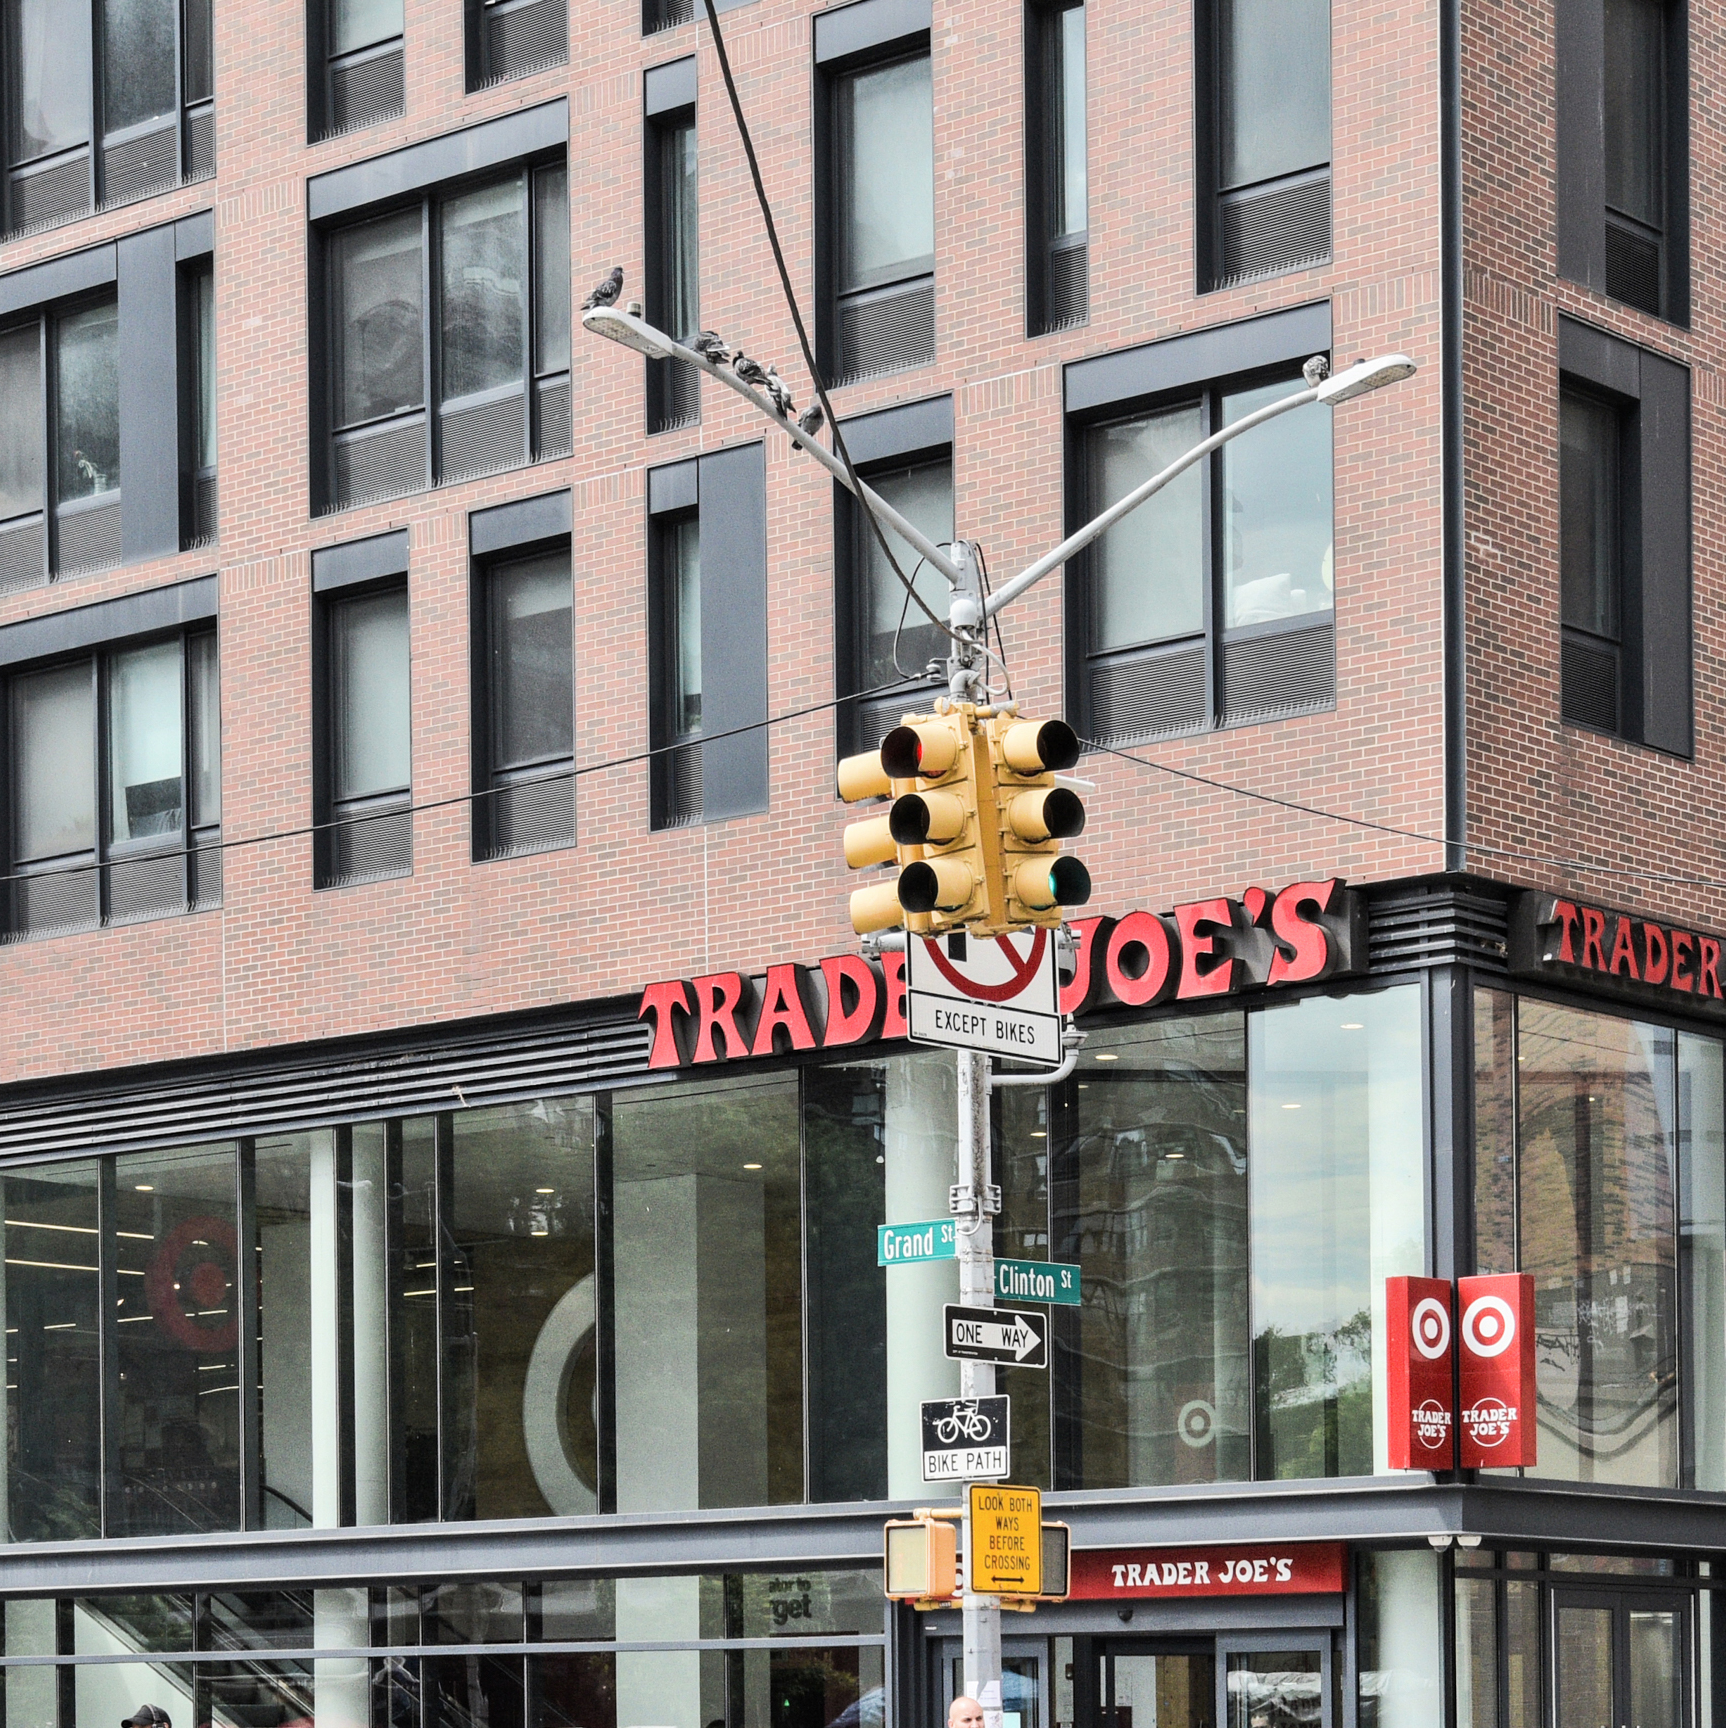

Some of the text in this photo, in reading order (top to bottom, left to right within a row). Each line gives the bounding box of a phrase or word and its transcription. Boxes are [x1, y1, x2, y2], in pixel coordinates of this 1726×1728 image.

[1550, 899, 1723, 999] TRADER
[636, 951, 906, 1069] TRADE
[935, 1009, 1035, 1045] EXCEPT BIKES
[883, 1224, 954, 1260] Grand St
[999, 1264, 1072, 1298] Clinton St
[956, 1322, 1029, 1348] ONE WAY
[1412, 1409, 1451, 1424] TRADER
[1462, 1407, 1517, 1423] TRADER
[1417, 1424, 1446, 1438] JOE'S
[1469, 1421, 1510, 1436] JOE'S
[928, 1451, 1002, 1473] BIKE PATH
[978, 1496, 1033, 1512] LOOK BOTH
[995, 1516, 1019, 1531] WAYS
[989, 1535, 1025, 1551] BEFORE
[984, 1555, 1031, 1570] CROSSING
[1111, 1556, 1293, 1587] TRADER JOE'S
